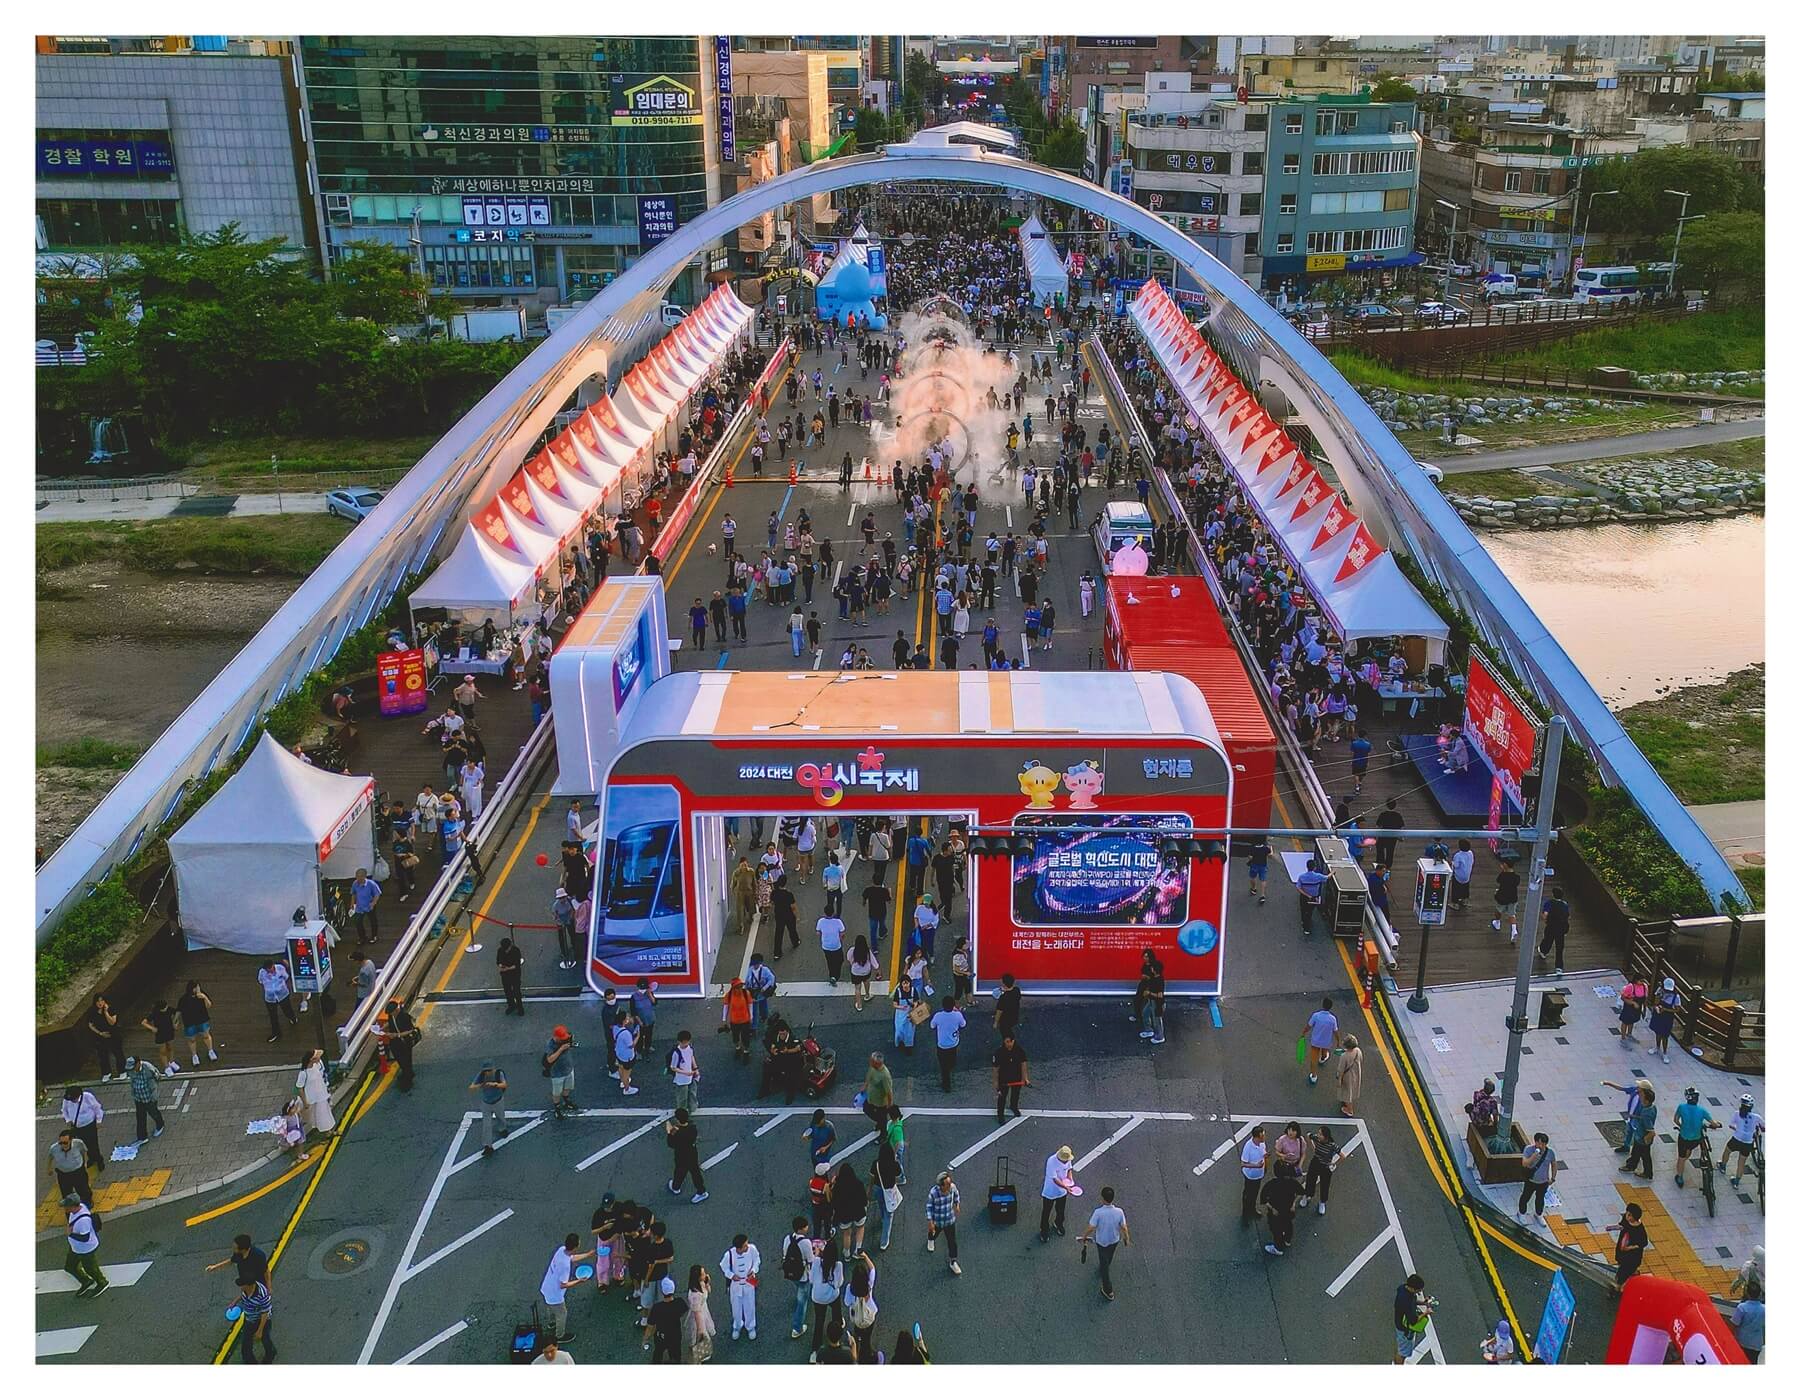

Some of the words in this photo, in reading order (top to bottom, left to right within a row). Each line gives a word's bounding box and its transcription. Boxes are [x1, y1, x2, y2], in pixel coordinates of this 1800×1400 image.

[636, 92, 688, 109] 임대문의
[631, 116, 693, 125] 010-9904-7117
[721, 99, 733, 160] 치과의원
[44, 148, 82, 165] 경찰
[92, 148, 132, 165] 학원
[1166, 154, 1215, 173] 대우당
[452, 178, 594, 193] 세상에하나뿐인치과의원
[645, 222, 674, 231] 치과의원
[474, 229, 536, 243] 코지약국
[739, 767, 766, 779] 2024
[767, 765, 793, 780] 대전
[1142, 758, 1194, 779] 현재존
[1048, 851, 1082, 868] 글로벌
[1085, 850, 1132, 868] 혁신도시
[1134, 851, 1158, 868] 대전
[1012, 939, 1041, 950] 대전을
[1043, 939, 1084, 950] 노래하다!
